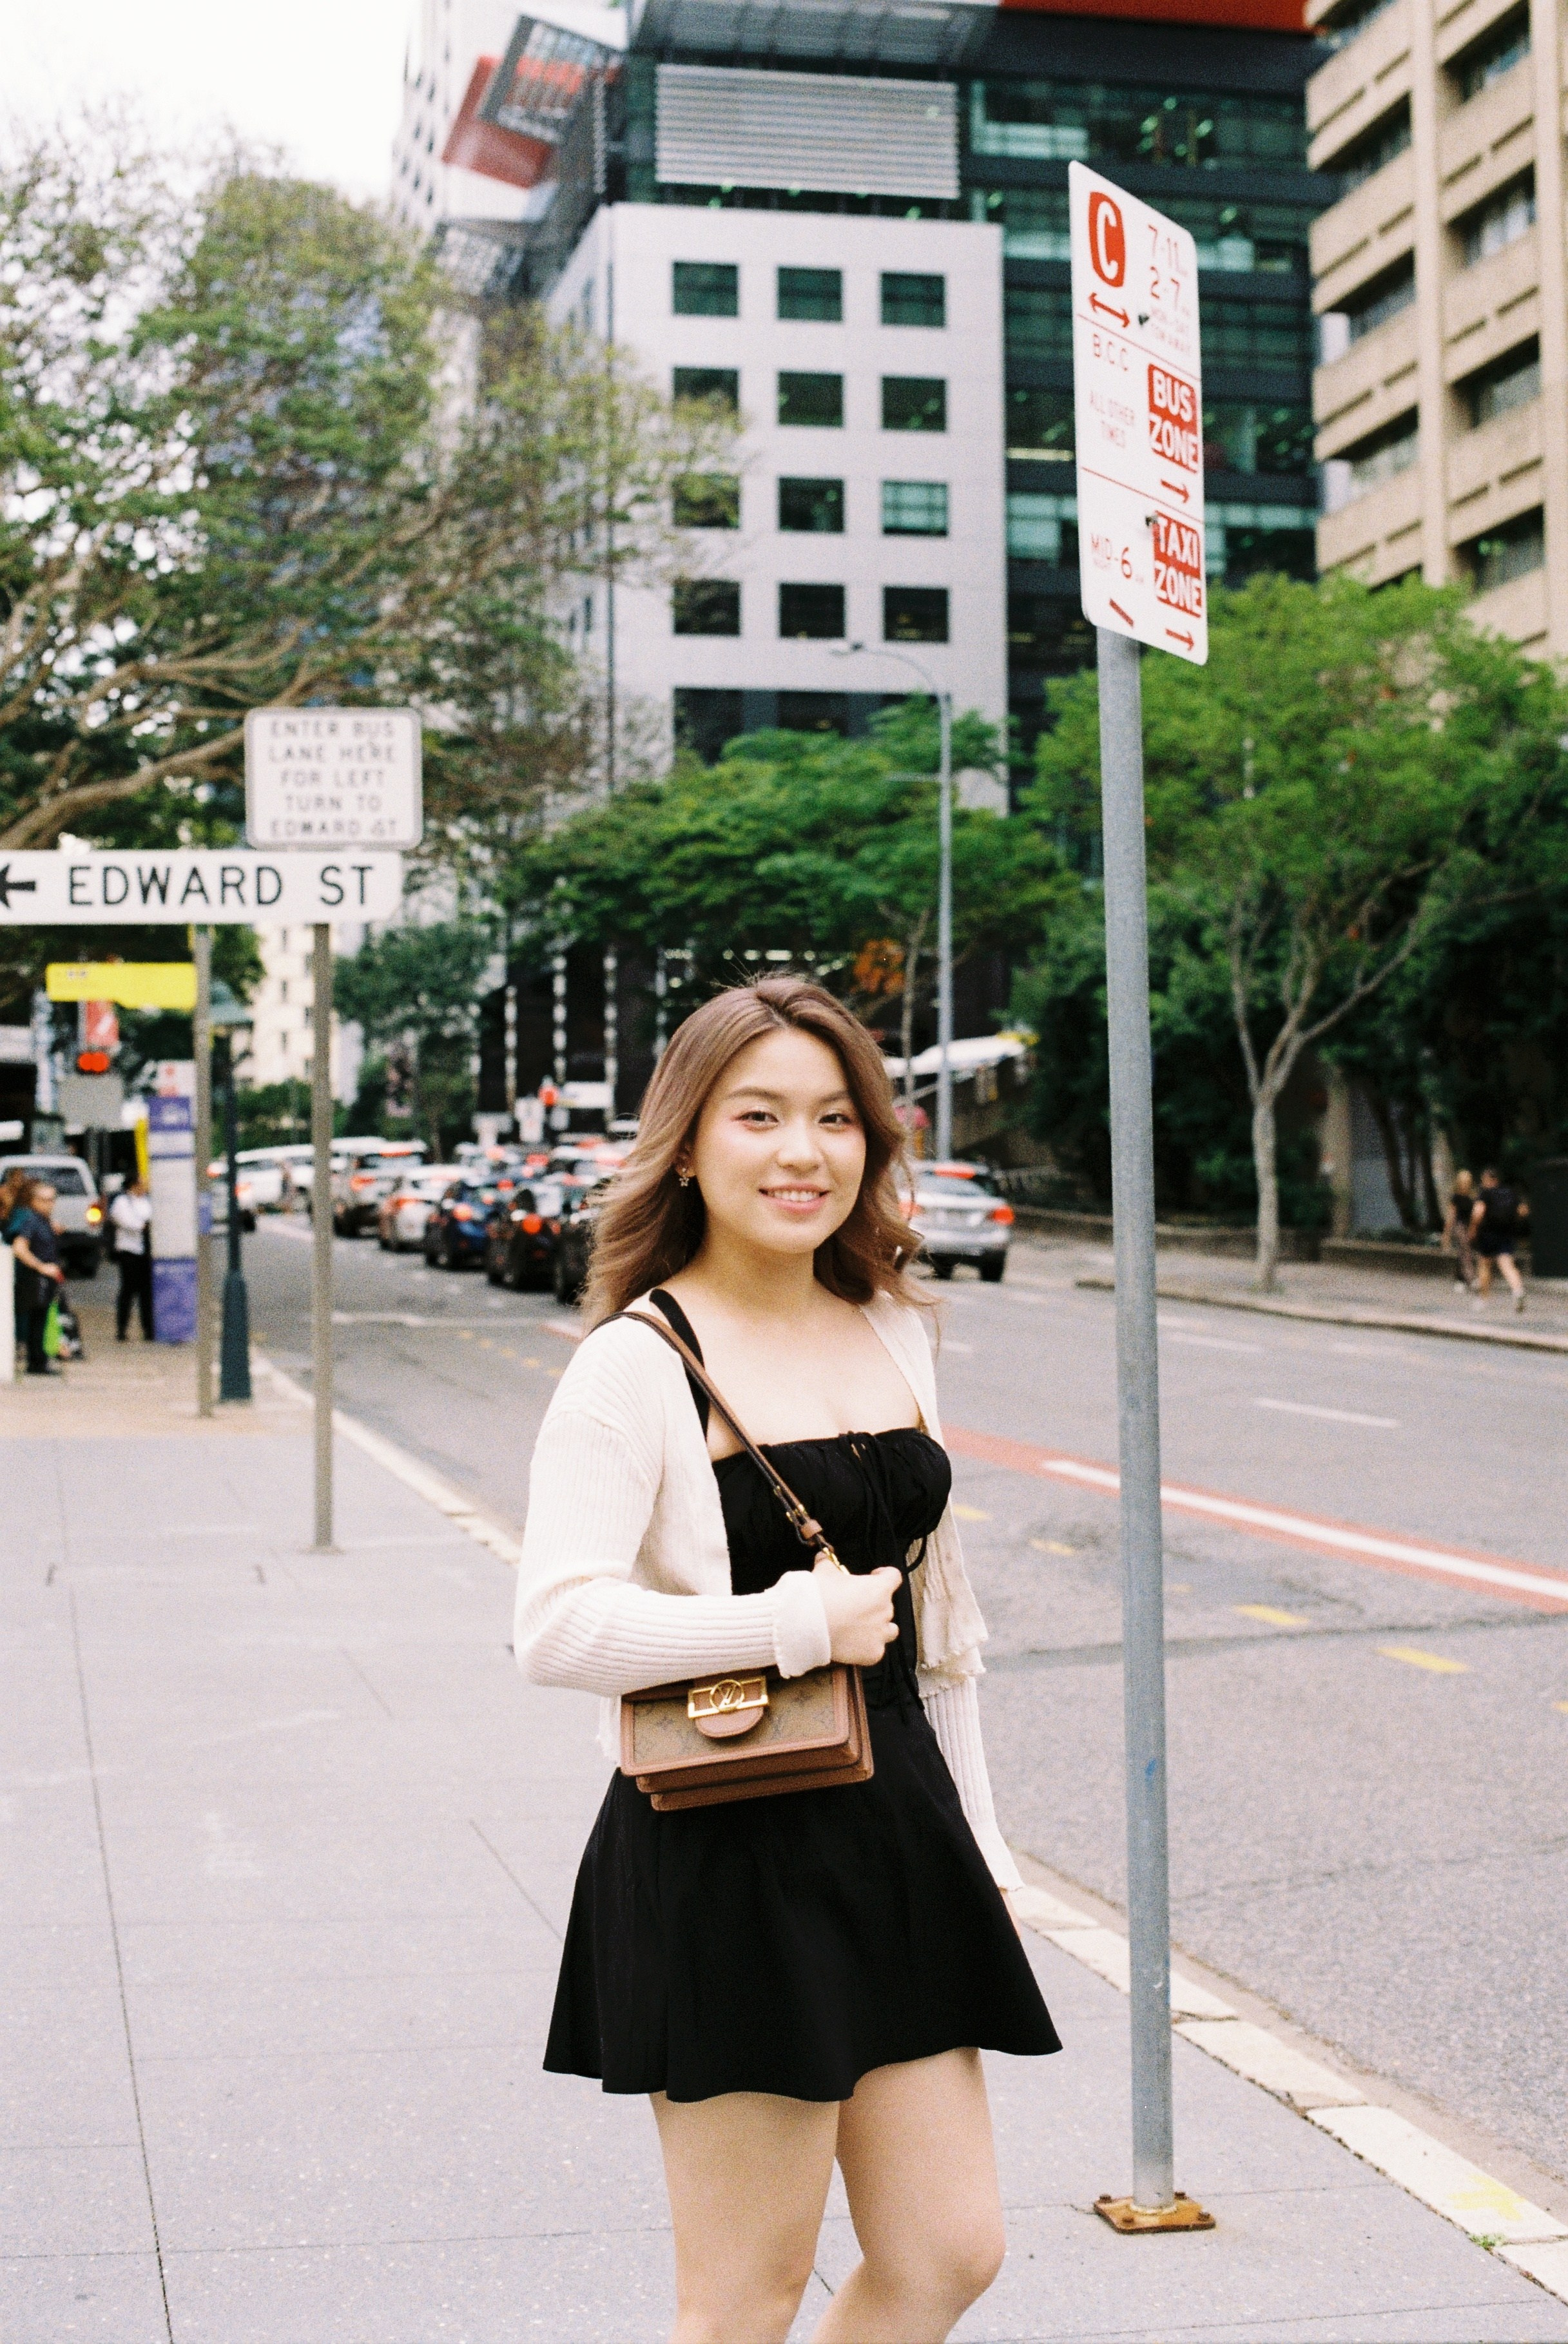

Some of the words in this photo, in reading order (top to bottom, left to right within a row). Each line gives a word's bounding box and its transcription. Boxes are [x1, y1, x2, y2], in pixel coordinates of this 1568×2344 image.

[1089, 389, 1105, 414] ALL
[1108, 397, 1135, 429] OTHER
[1154, 371, 1192, 421] BUS
[1148, 412, 1199, 470] ZONE
[1156, 516, 1197, 568] TAXI
[1154, 560, 1203, 615] ZONE
[271, 720, 339, 738] ENTER
[353, 720, 394, 739] BUS
[269, 744, 325, 764] LANE
[340, 744, 395, 764] HERE
[281, 769, 322, 788] FOR
[334, 769, 385, 788] LEFT
[285, 794, 342, 813] TURN
[357, 794, 382, 813] TO
[271, 818, 362, 838] EDWARD
[68, 865, 284, 906] EDWARD
[319, 865, 374, 906] ST
